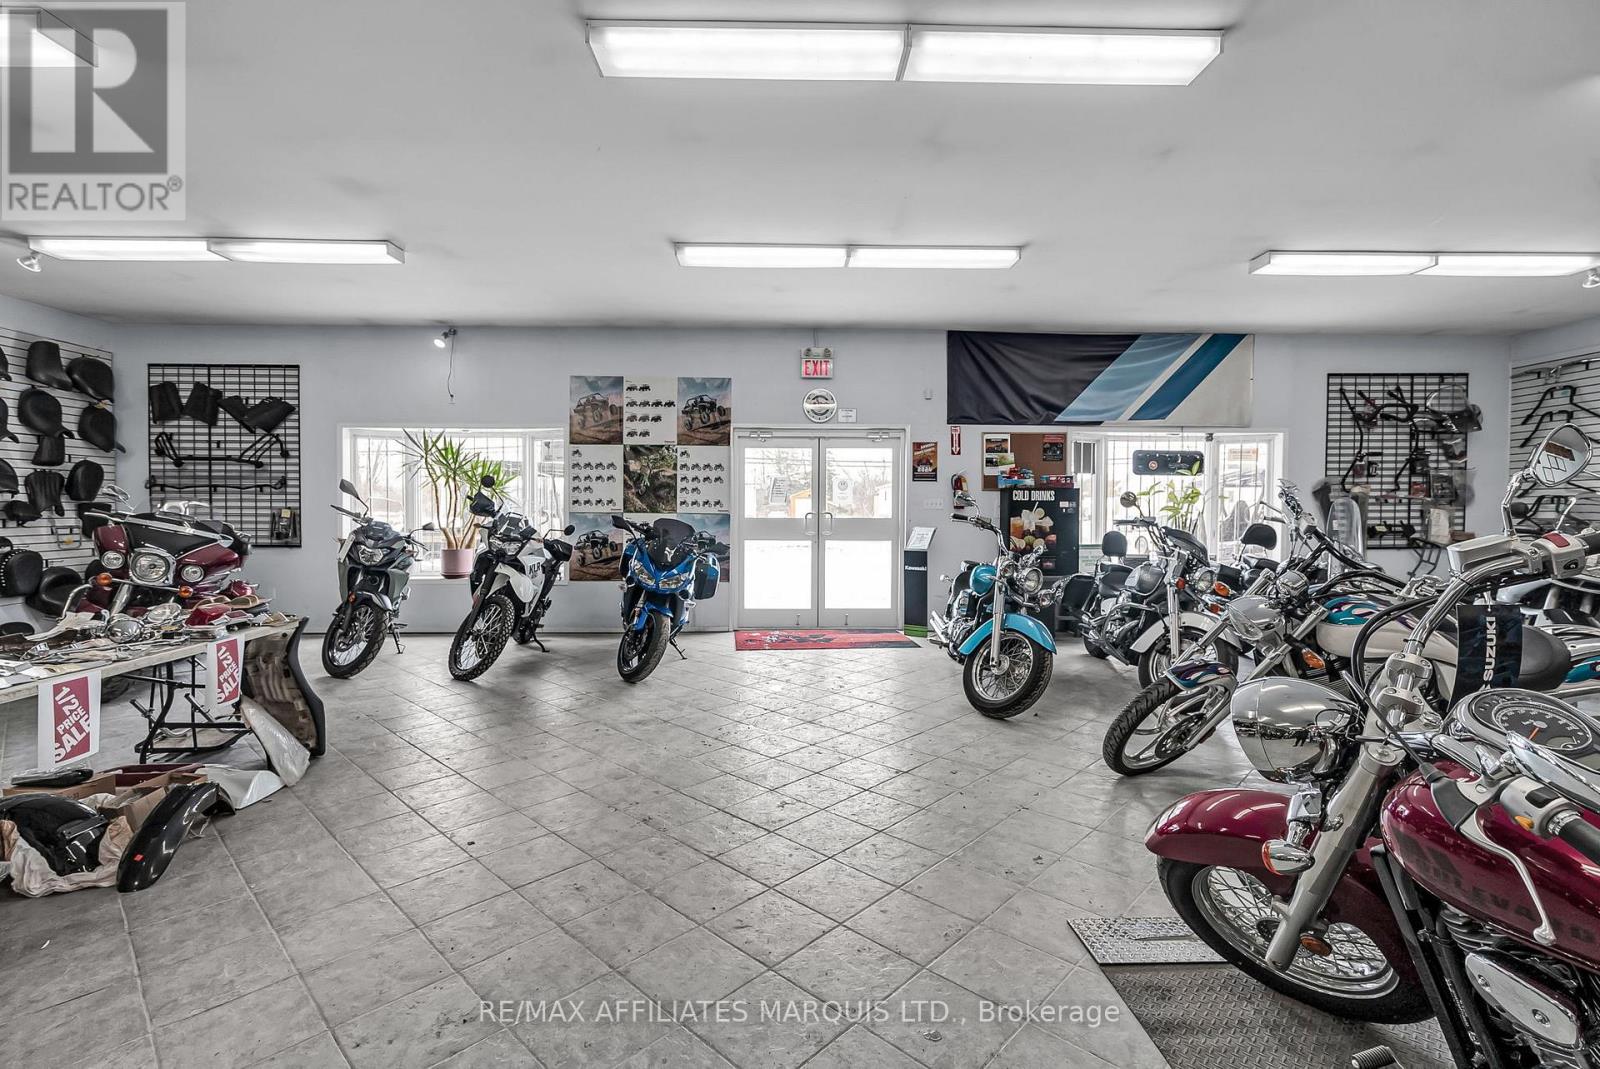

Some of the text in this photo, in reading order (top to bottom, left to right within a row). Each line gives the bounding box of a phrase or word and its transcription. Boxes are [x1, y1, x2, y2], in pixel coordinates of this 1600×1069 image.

[804, 359, 831, 376] EXIT
[1012, 490, 1056, 501] COLD DRINKS
[217, 645, 233, 669] 1/2
[1482, 616, 1497, 682] SUZUKI
[219, 661, 238, 683] PRICE
[54, 686, 80, 716] 1/2
[56, 705, 86, 735] PRICE
